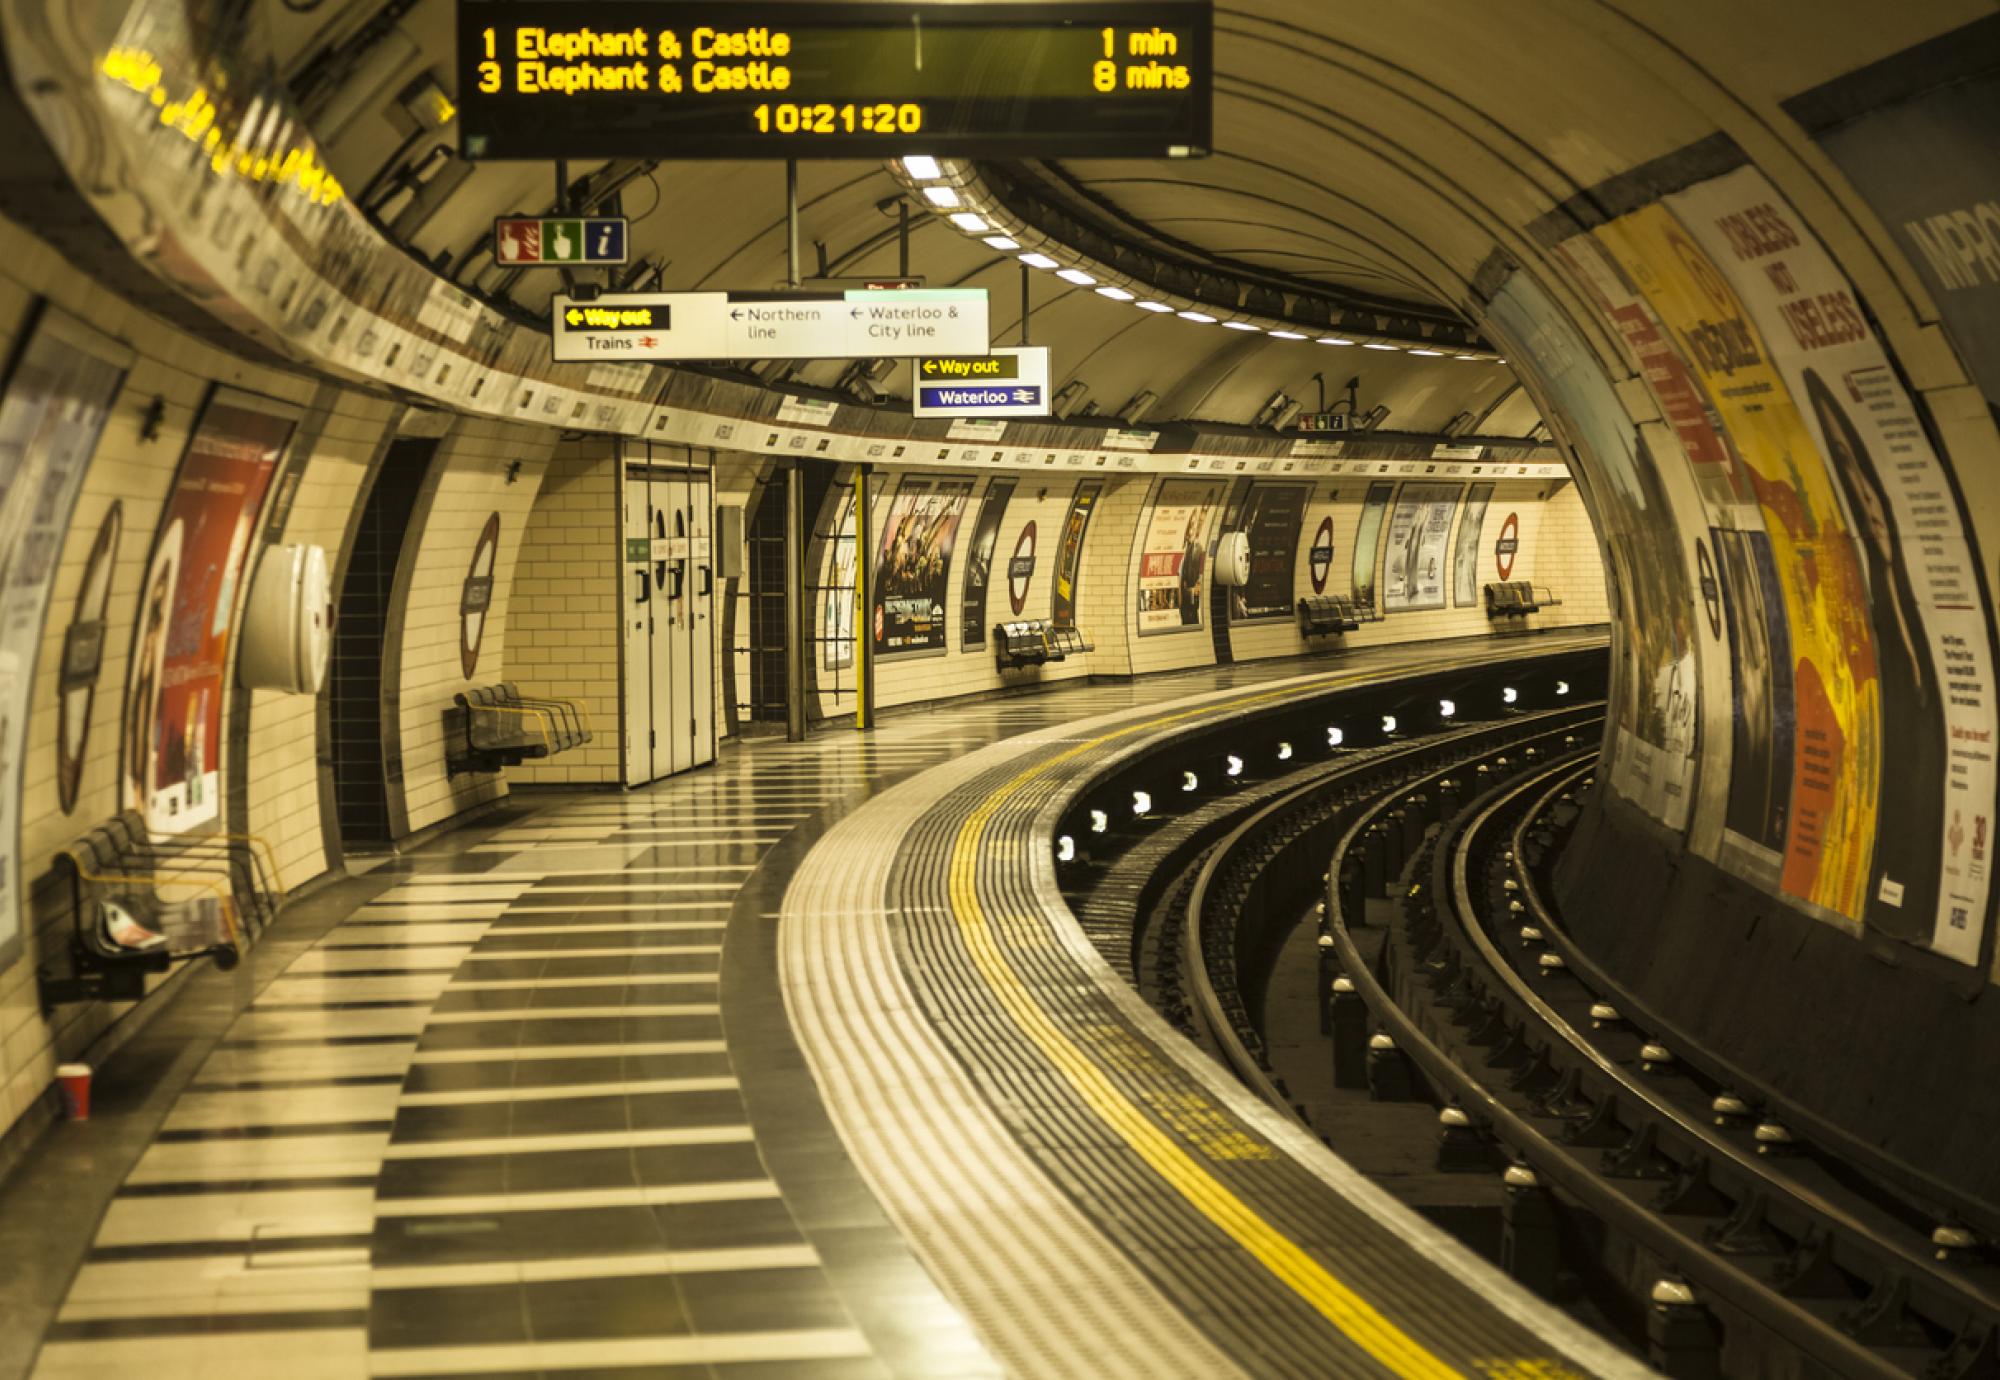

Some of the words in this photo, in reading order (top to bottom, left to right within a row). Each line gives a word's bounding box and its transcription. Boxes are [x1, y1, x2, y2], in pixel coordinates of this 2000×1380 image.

[483, 27, 496, 60] 1
[516, 27, 649, 61] Elephant
[658, 29, 683, 60] &
[691, 27, 791, 60] Castle
[1101, 27, 1115, 59] 1
[1128, 27, 1178, 57] min
[478, 61, 502, 94] 3
[516, 61, 649, 96] Elephant
[658, 63, 683, 94] &
[691, 61, 792, 93] Castle
[1092, 60, 1117, 93] 8
[1125, 60, 1191, 90] mins
[753, 103, 922, 134] 10:21:20
[584, 307, 620, 330] Way
[620, 308, 652, 326] out
[747, 308, 822, 322] Northern
[868, 306, 943, 320] Waterloo
[948, 307, 959, 319] &
[1777, 289, 1867, 352] USELESS
[747, 325, 777, 339] line
[867, 323, 901, 338] City
[906, 323, 936, 337] line
[585, 336, 633, 351] Trains
[939, 360, 971, 377] Way
[972, 360, 1000, 374] out
[938, 390, 1008, 405] Waterloo
